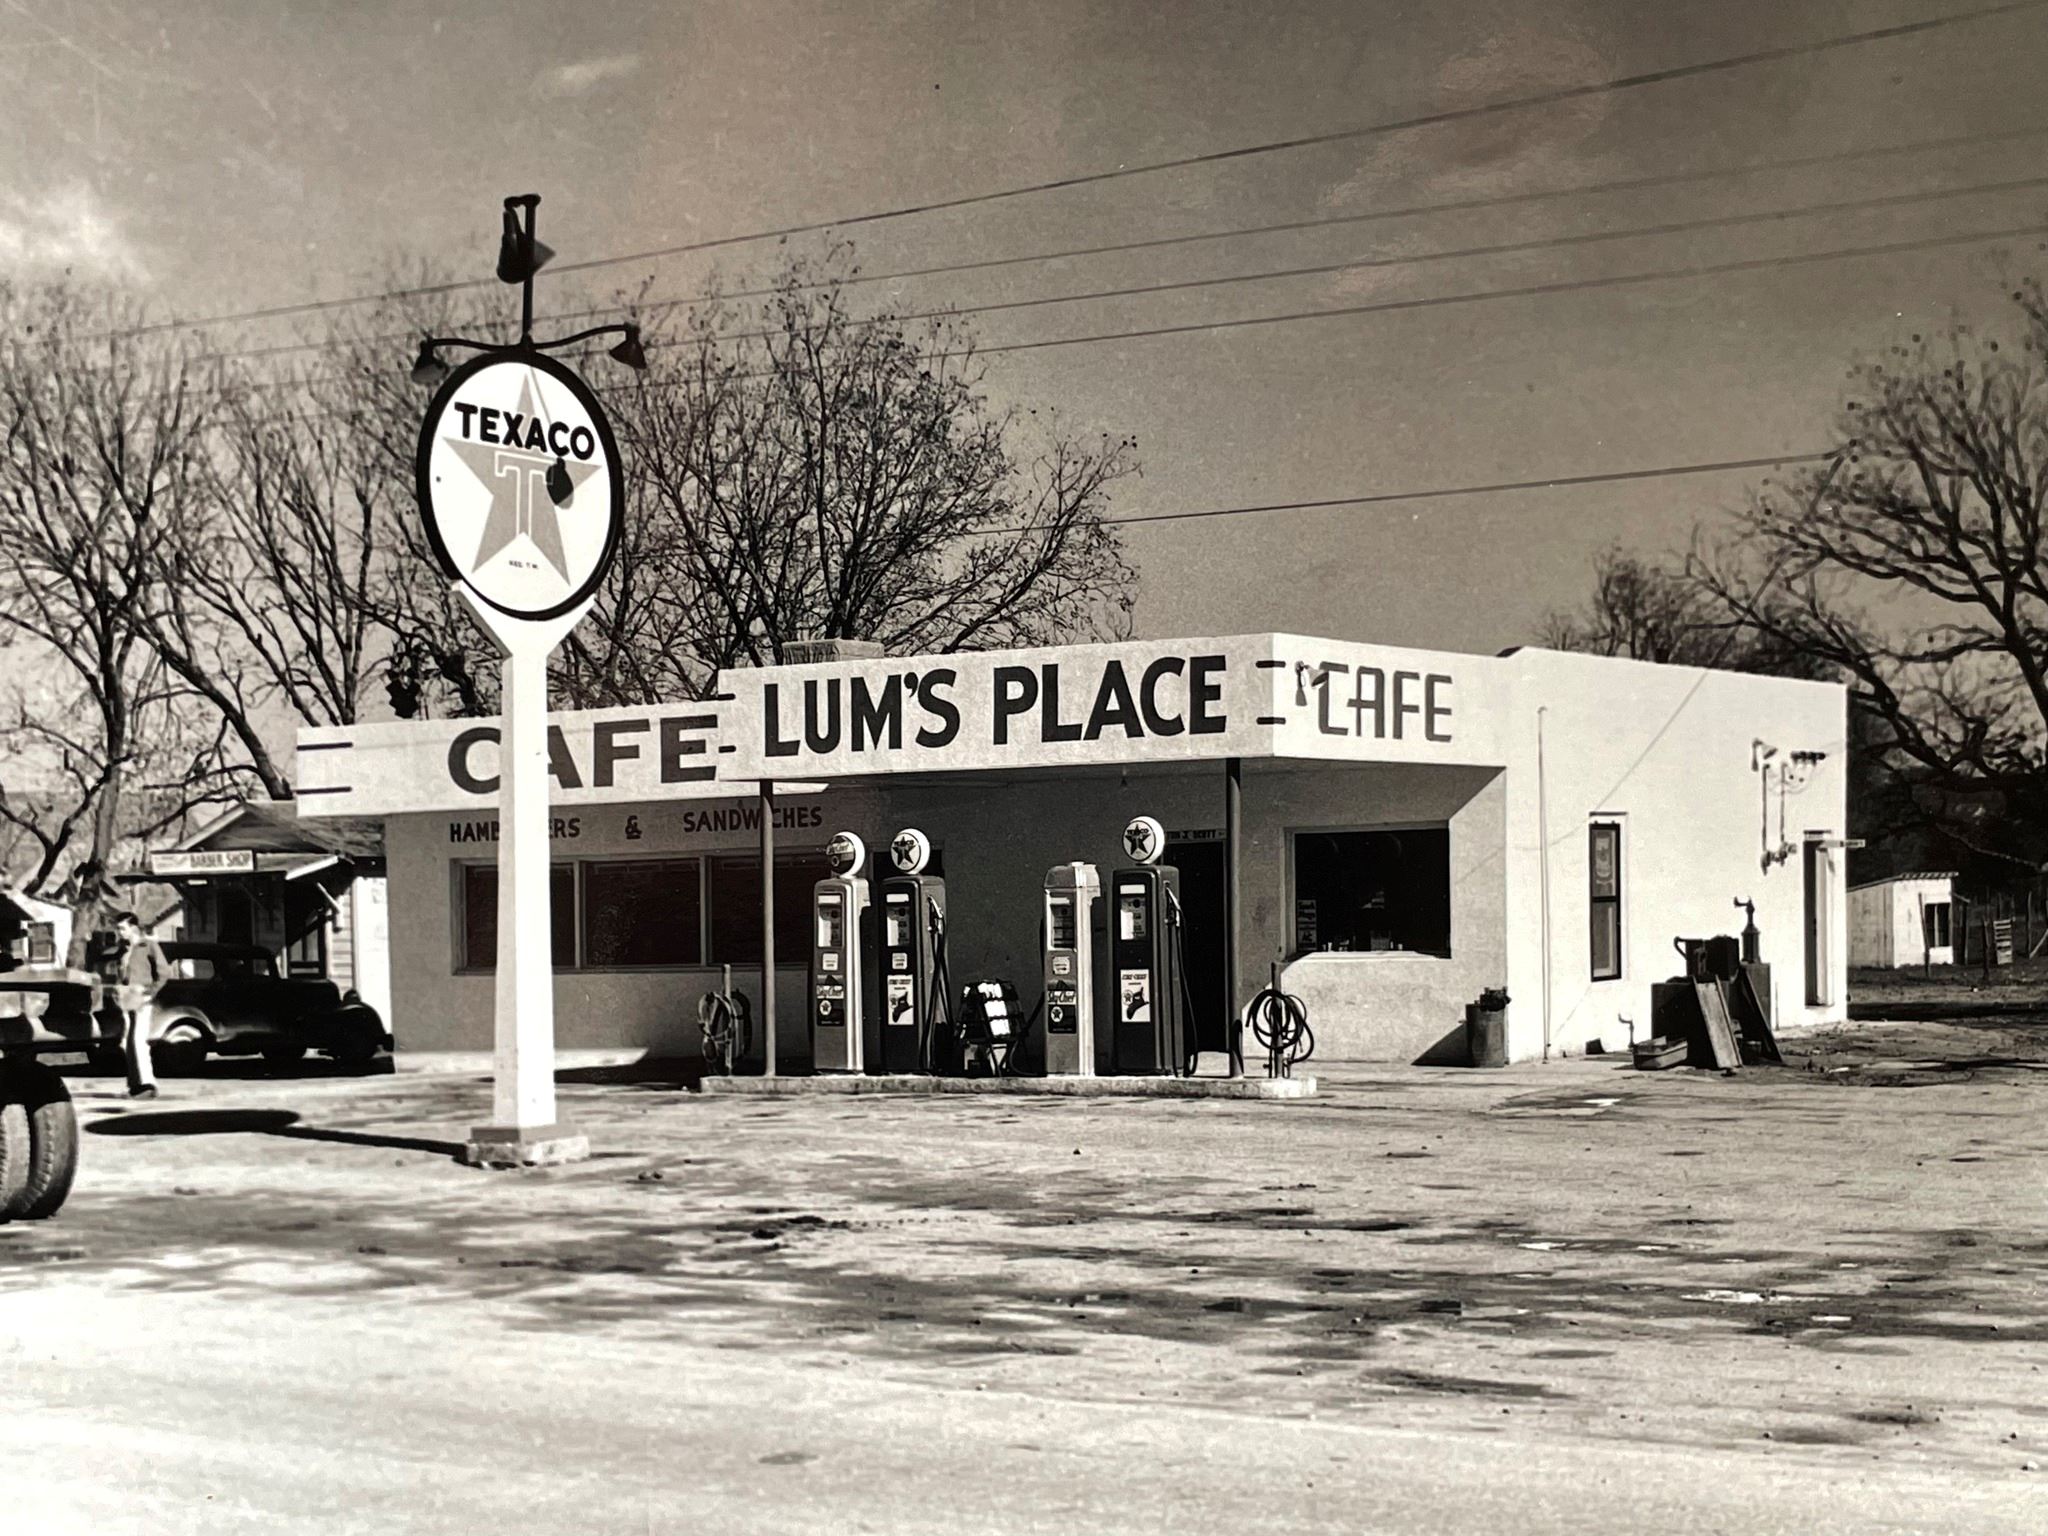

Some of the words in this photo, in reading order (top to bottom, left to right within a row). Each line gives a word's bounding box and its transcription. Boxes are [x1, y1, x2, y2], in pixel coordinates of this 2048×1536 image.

[453, 401, 595, 460] TEXACO
[763, 668, 961, 758] LUM'S
[993, 655, 1228, 745] PLACE
[1318, 661, 1453, 743] CAFE
[625, 816, 642, 840] &
[683, 806, 822, 833] SANDWCHES
[226, 852, 251, 867] SHOP
